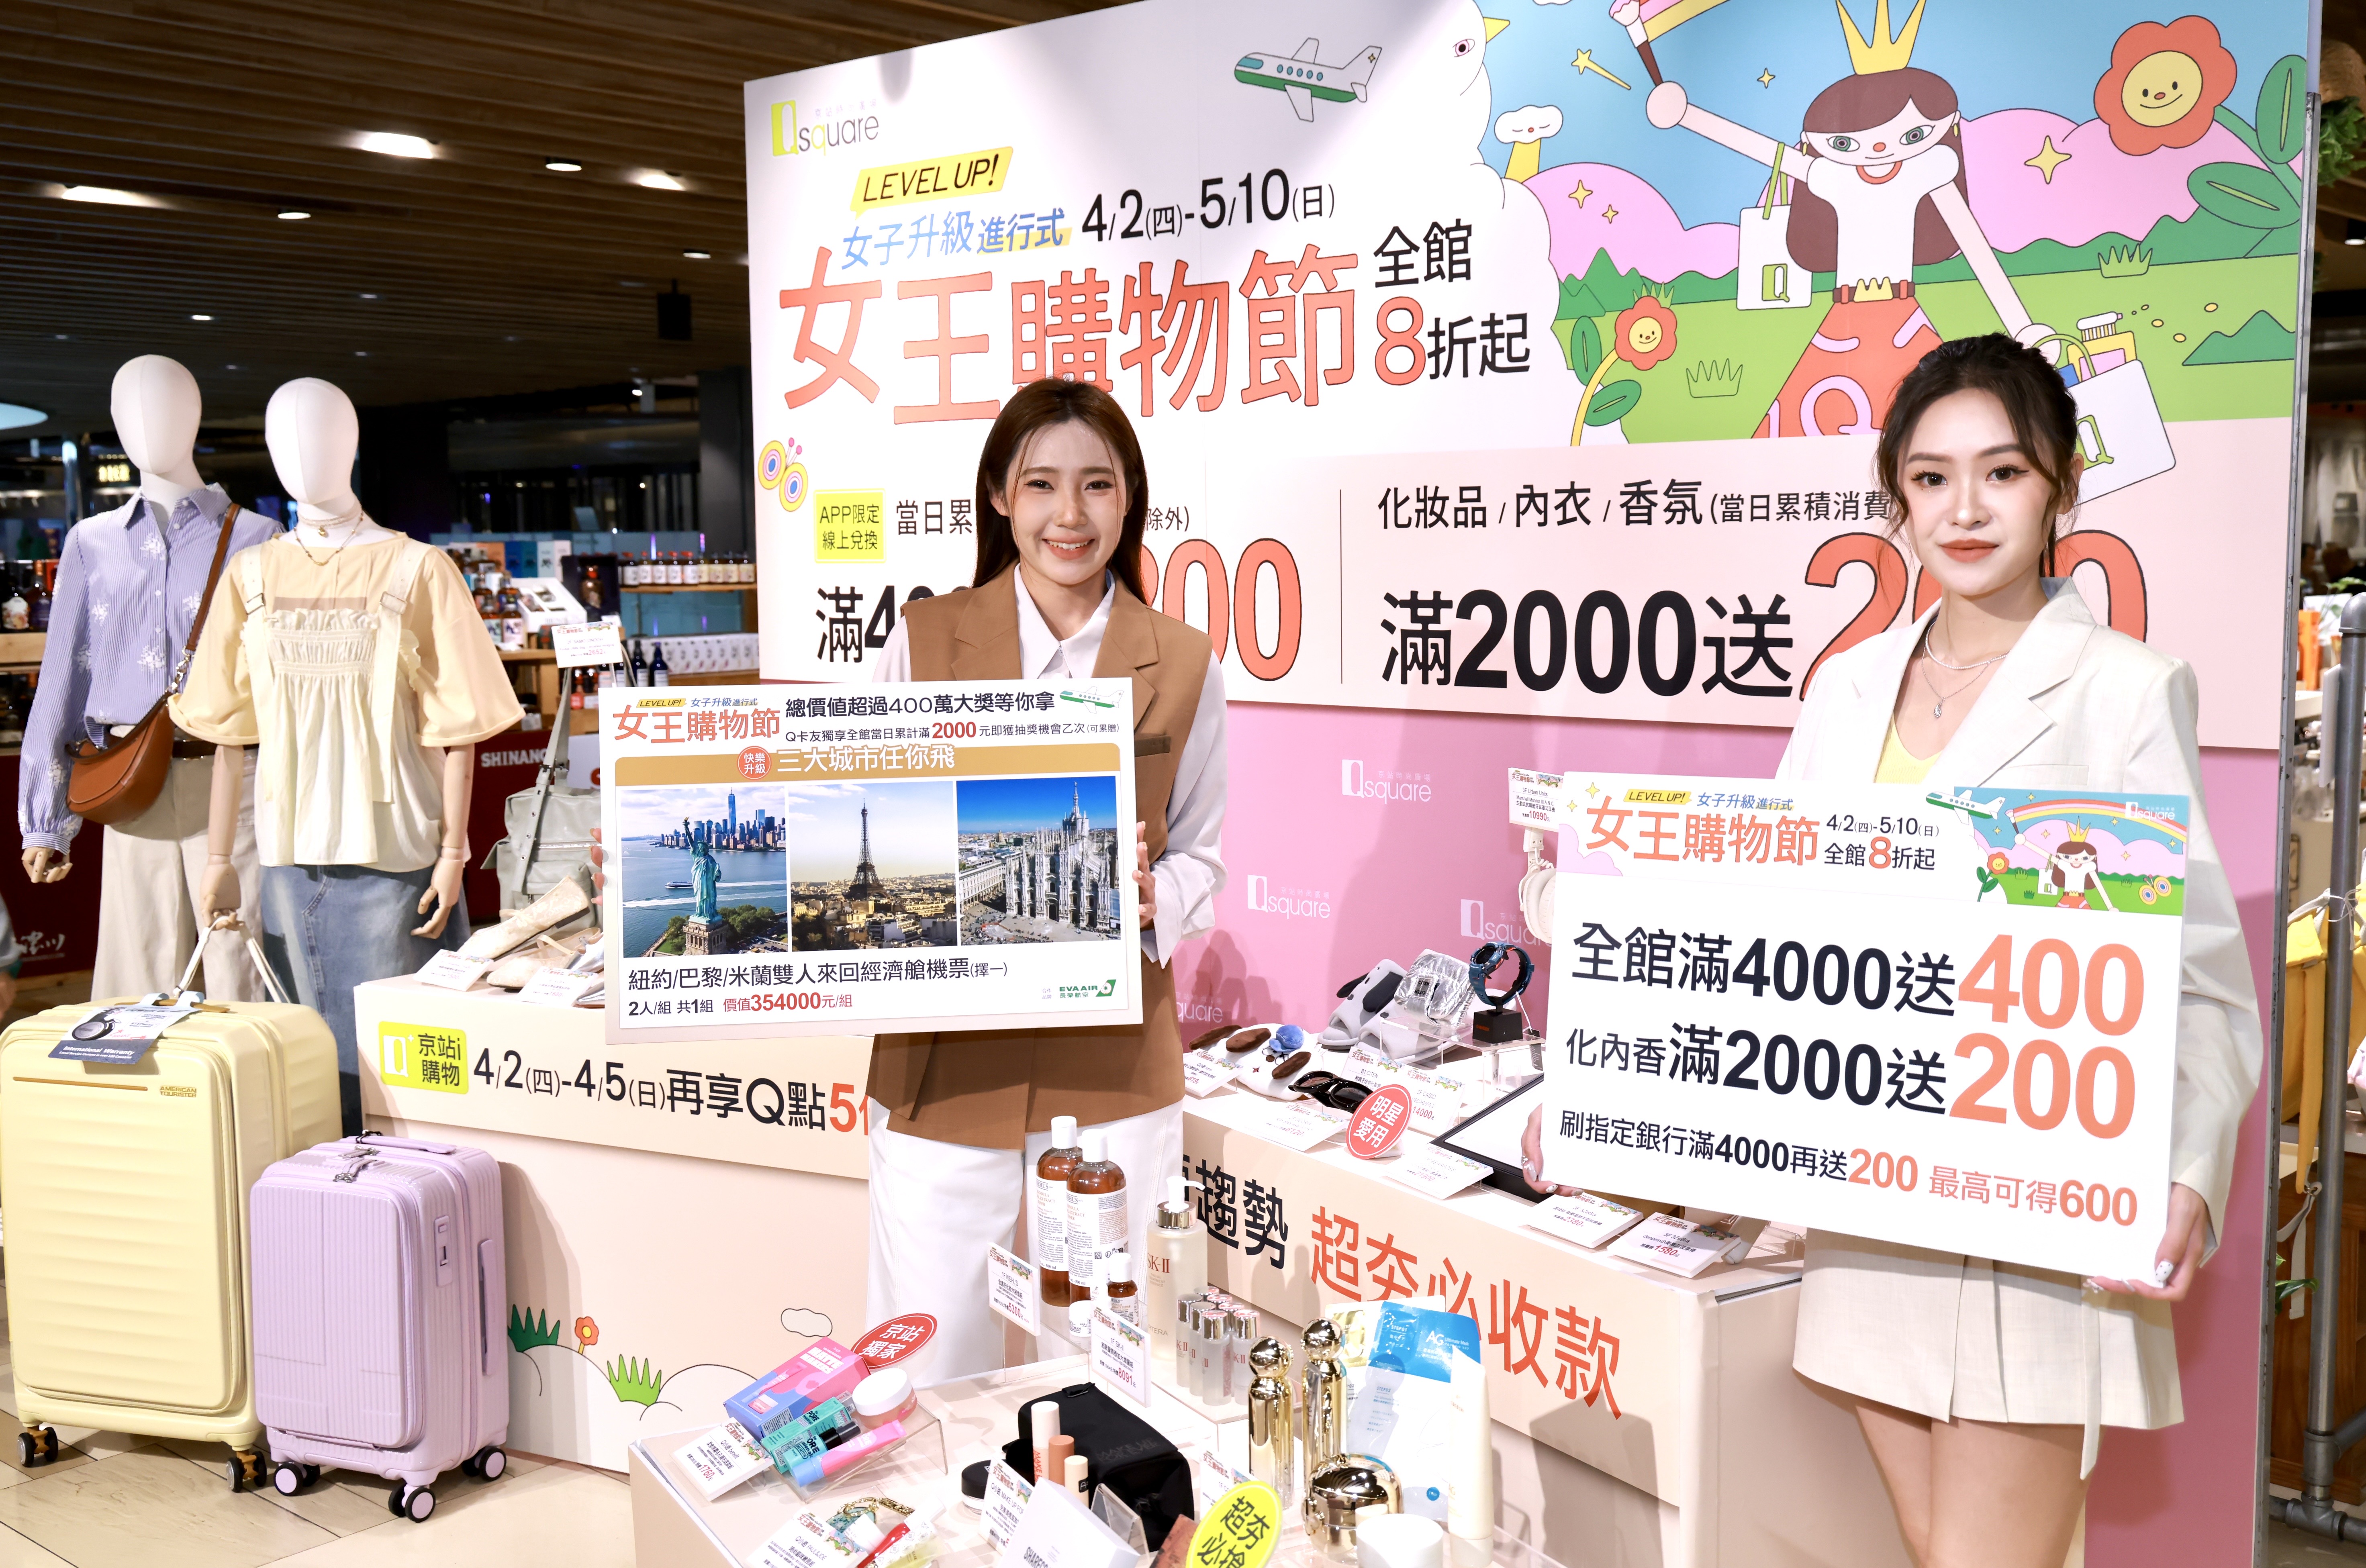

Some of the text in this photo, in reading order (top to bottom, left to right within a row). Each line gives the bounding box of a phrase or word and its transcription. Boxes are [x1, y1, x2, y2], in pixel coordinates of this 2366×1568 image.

[862, 153, 1000, 203] LEVEL UP!
[841, 207, 1065, 270] 女子升級進行式
[1373, 218, 1472, 288] 全館
[779, 243, 1358, 425] 女王購物節
[1375, 296, 1530, 386] 8折起
[819, 503, 880, 525] APP限定
[822, 529, 879, 552] 線上兌換
[1142, 538, 1302, 681] 00
[667, 698, 682, 706] UP!
[691, 697, 758, 707] 女子升級進行式
[785, 691, 1055, 718] 總價值超過400萬大獎等你拿
[613, 704, 780, 743] 女王購物節
[744, 752, 765, 763] 快樂
[777, 744, 955, 772] 三大城市任你飛
[744, 764, 765, 774] 升級
[1378, 770, 1430, 782] 京站時尚廣場
[1629, 791, 1686, 803] LEVEL UP!
[1697, 792, 1793, 811] 女子升級進行式
[1586, 796, 1821, 865] 女王購物節
[1461, 899, 1552, 947] Qsqua
[1572, 922, 2144, 1036] 全館滿4000送400
[629, 992, 853, 1016] 2人/組 共1組 價值354000元/組
[1176, 1002, 1223, 1023] quare
[103, 1047, 135, 1056] Warranty
[422, 1060, 460, 1087] 購物
[1367, 1070, 1378, 1078] CITEN
[1565, 1022, 2136, 1139] 化內香滿2000送200
[1422, 1091, 1436, 1100] CASIO
[1369, 1095, 1404, 1127] 明星
[1353, 1117, 1389, 1148] 愛用
[1559, 1109, 2138, 1226] 刷指定銀行滿4000再送200 最高可得600
[1671, 1235, 1690, 1243] 3ZeBra
[1006, 1274, 1018, 1286] KIEHL'S
[1182, 1154, 1621, 1420] 趨勢 超夯必收款
[880, 1323, 925, 1343] 京站
[1426, 1331, 1444, 1345] AG
[859, 1340, 907, 1360] 獨家
[1116, 1340, 1124, 1351] SK-II
[1176, 1339, 1188, 1352] K-II
[799, 1353, 834, 1374] MAKERS
[807, 1346, 844, 1370] MATTE
[806, 1410, 820, 1422] PORE
[728, 1448, 740, 1459] benefit
[807, 1438, 820, 1454] ORE
[1001, 1491, 1011, 1504] MAKE
[1220, 1496, 1270, 1550] 超夯
